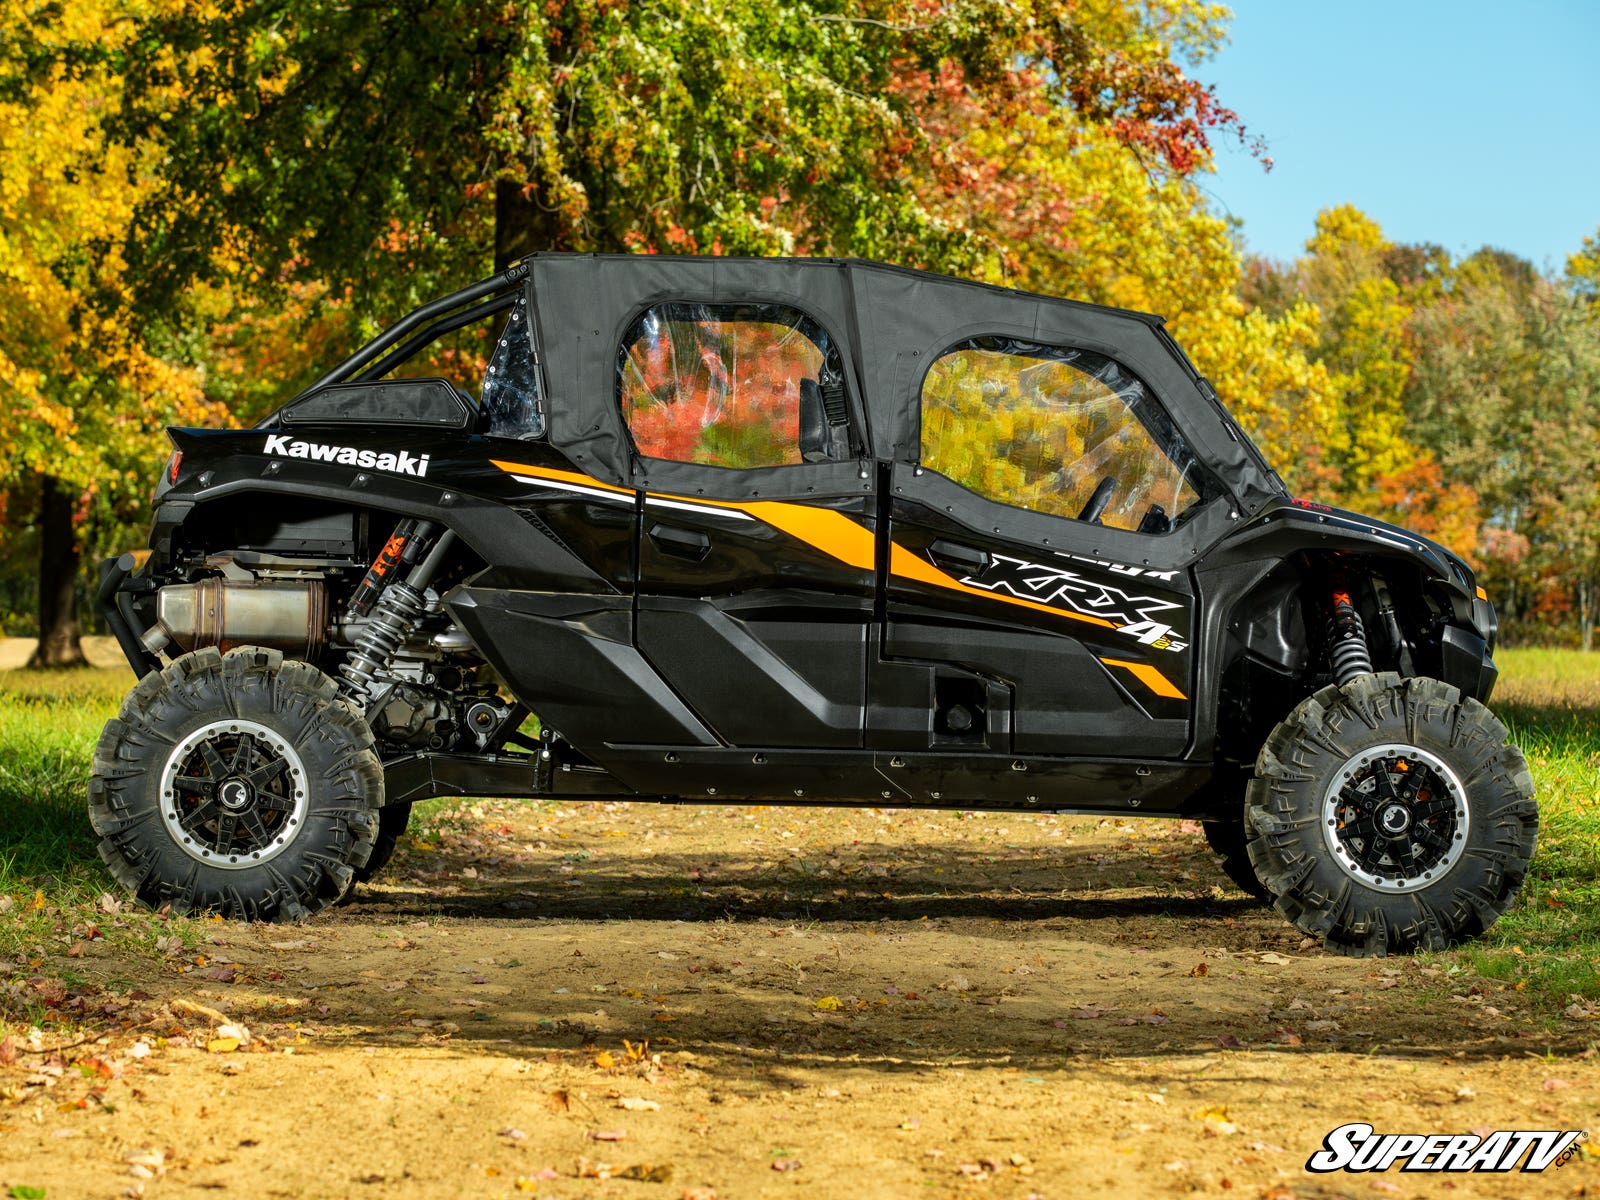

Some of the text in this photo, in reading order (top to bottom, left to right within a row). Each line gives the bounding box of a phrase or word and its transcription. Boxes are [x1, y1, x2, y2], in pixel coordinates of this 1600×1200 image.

[263, 434, 431, 477] Kawasaki
[370, 532, 405, 577] FOX
[959, 553, 1184, 624] KRX
